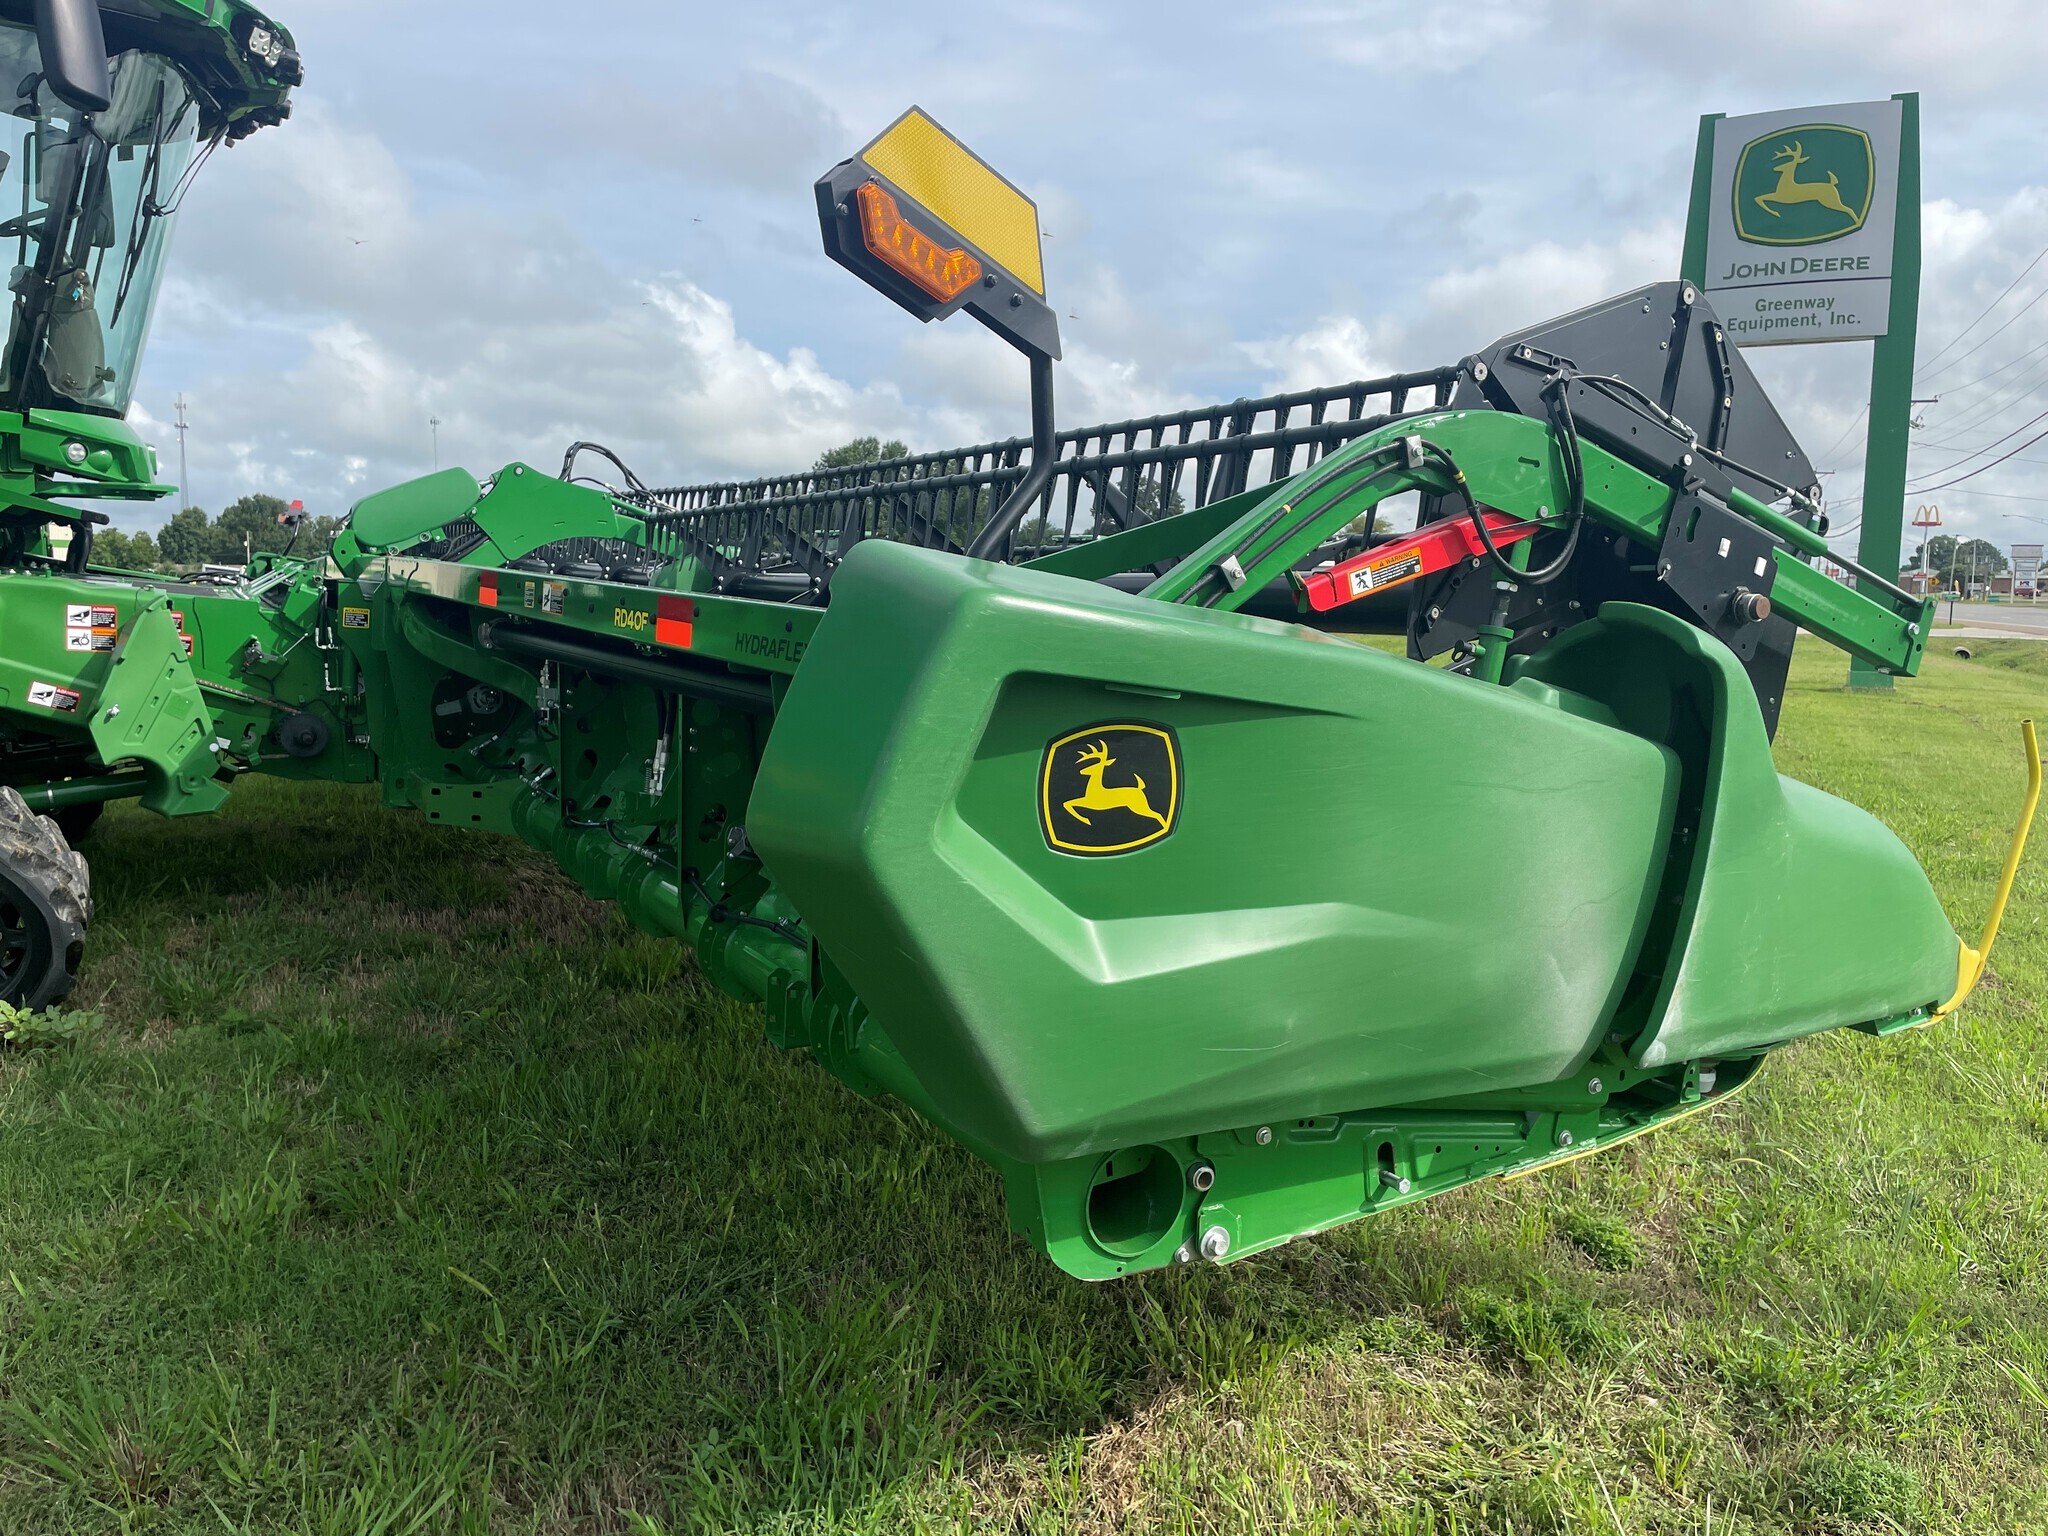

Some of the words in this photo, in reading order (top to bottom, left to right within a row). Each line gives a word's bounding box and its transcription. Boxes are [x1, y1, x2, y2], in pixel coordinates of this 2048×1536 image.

[1723, 262, 1785, 280] JOHN
[1790, 256, 1870, 274] DEERE
[1755, 297, 1835, 313] Greenway
[1728, 313, 1821, 333] Equipment,
[1830, 312, 1861, 325] Inc.
[1385, 551, 1413, 564] WARNING
[614, 607, 649, 632] RD40F
